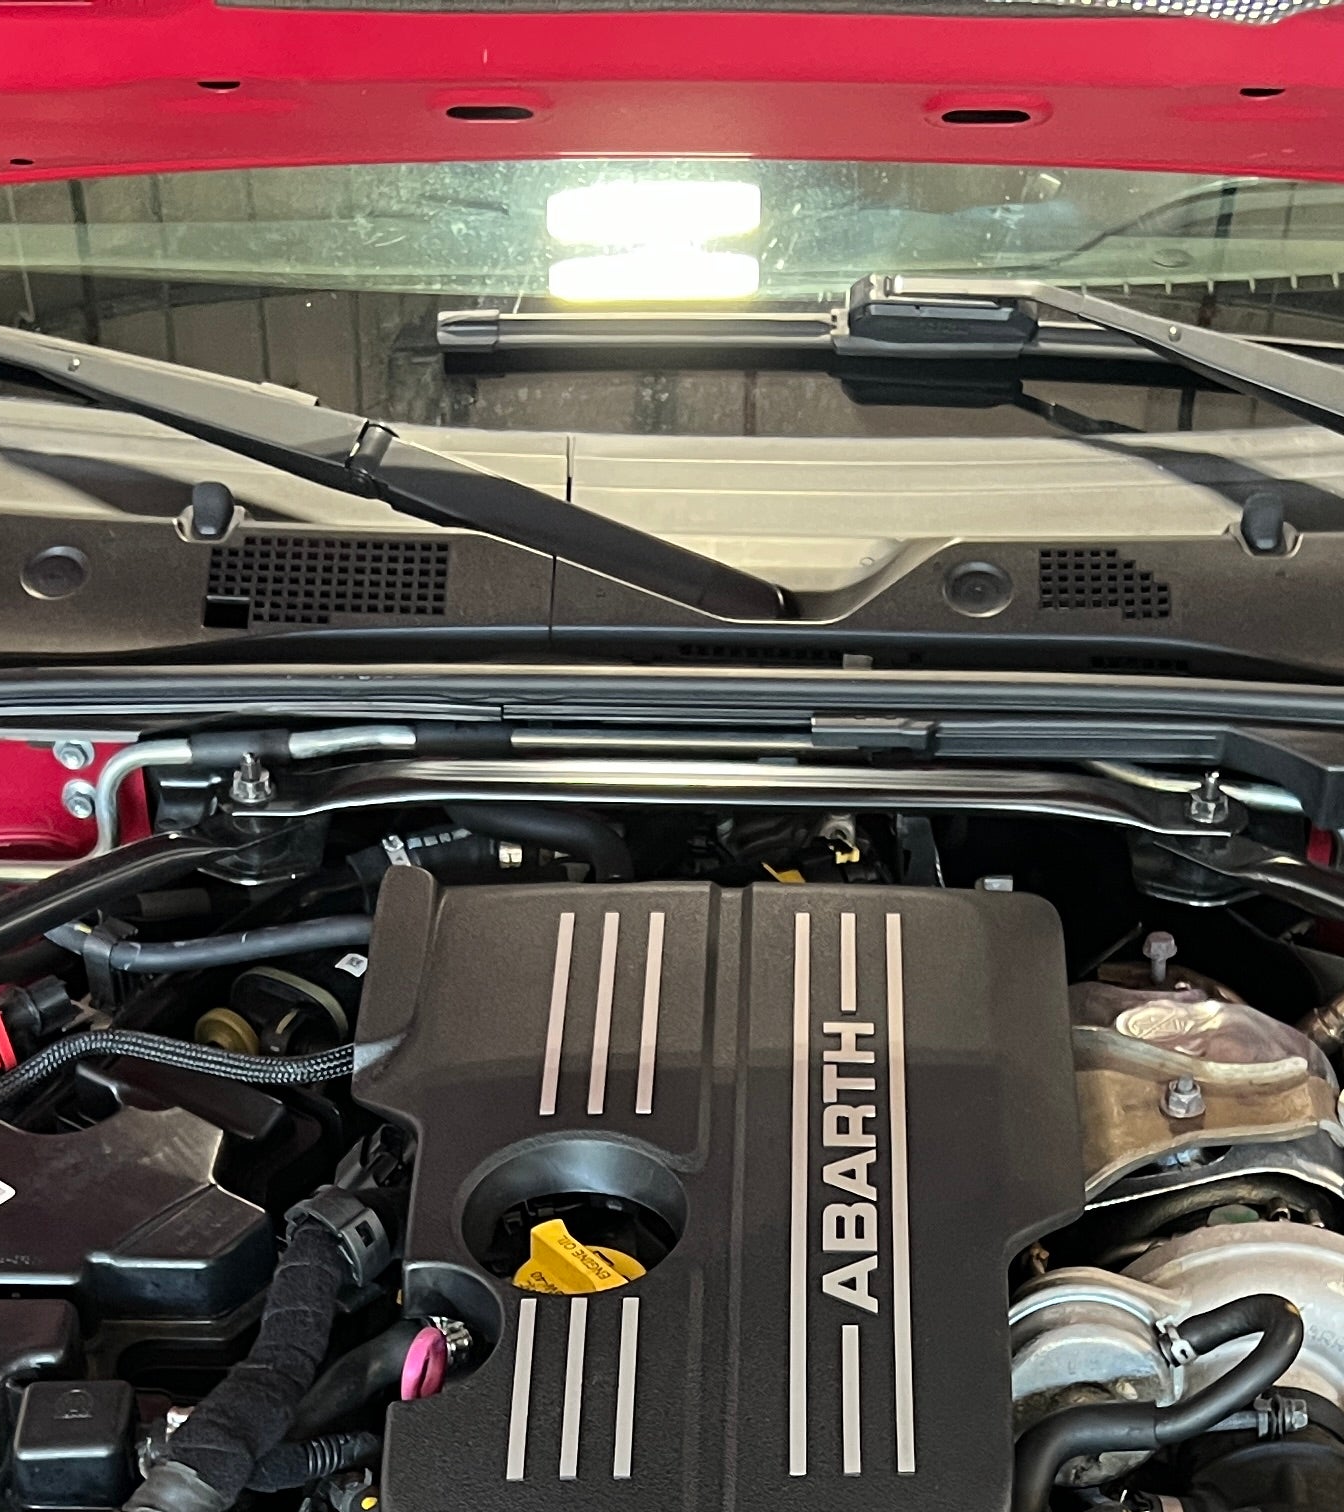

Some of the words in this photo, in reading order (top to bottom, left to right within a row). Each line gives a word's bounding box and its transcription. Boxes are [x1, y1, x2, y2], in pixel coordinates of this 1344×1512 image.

[823, 1021, 878, 1314] ABARTH
[557, 1234, 577, 1250] OIL
[571, 1249, 611, 1280] ENGINE
